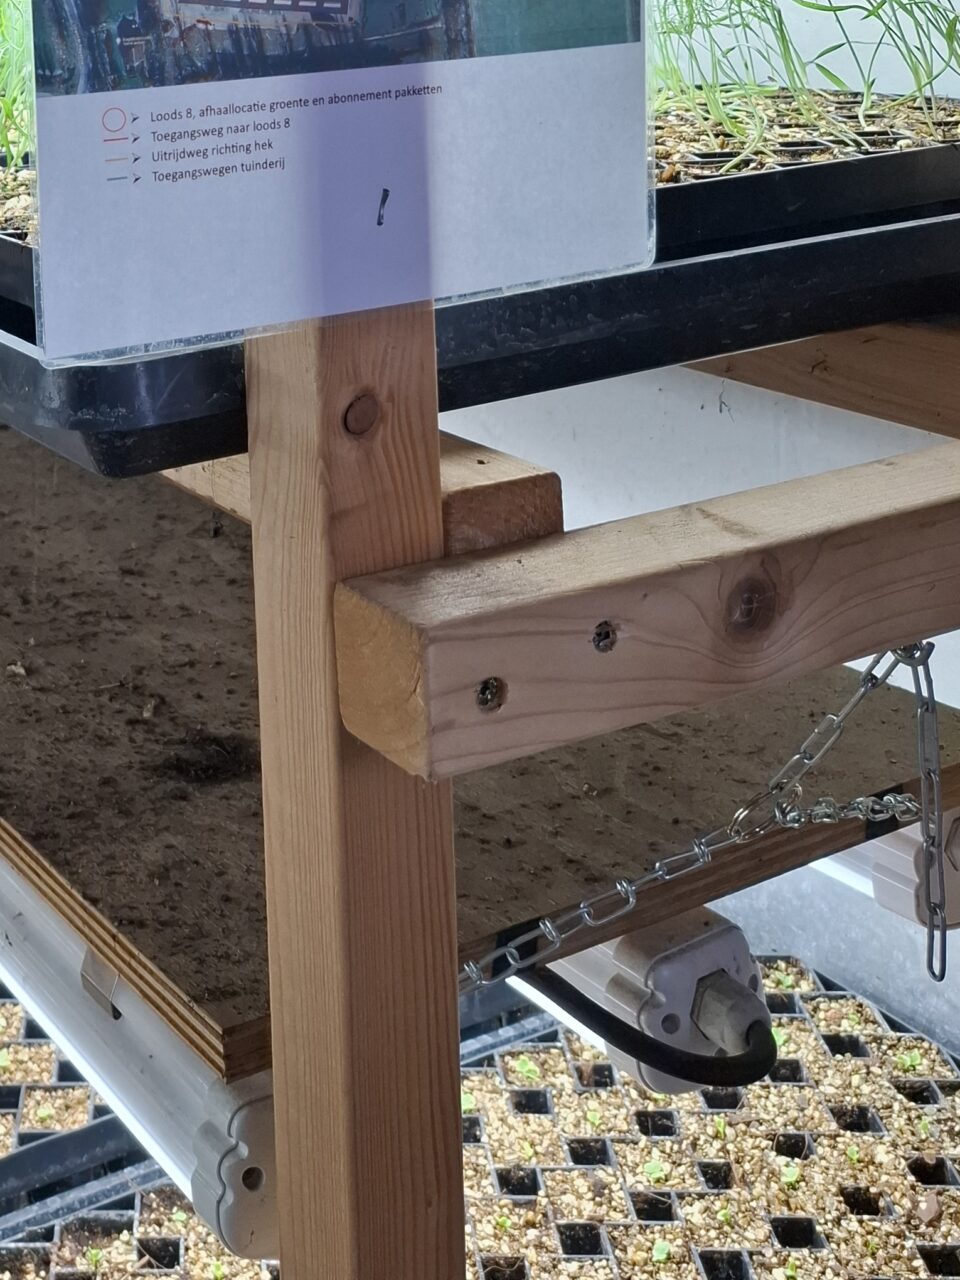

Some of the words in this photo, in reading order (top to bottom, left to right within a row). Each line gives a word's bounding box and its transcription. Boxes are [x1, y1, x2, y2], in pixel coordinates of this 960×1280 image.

[150, 108, 183, 122] Loods
[185, 107, 196, 120] 8,
[199, 100, 266, 118] afhaallocatie
[269, 98, 310, 113] groente
[312, 96, 325, 106] en
[328, 89, 392, 104] abonnement
[394, 84, 443, 100] pakketten
[151, 127, 224, 143] Toegangsweg
[226, 123, 251, 135] naar
[253, 119, 281, 132] loods
[283, 117, 291, 129] 8
[151, 147, 209, 163] Uitrijdweg
[211, 141, 252, 156] richting
[254, 138, 274, 151] hek
[152, 163, 238, 183] Toegangswegen
[240, 156, 286, 173] tuinderij
